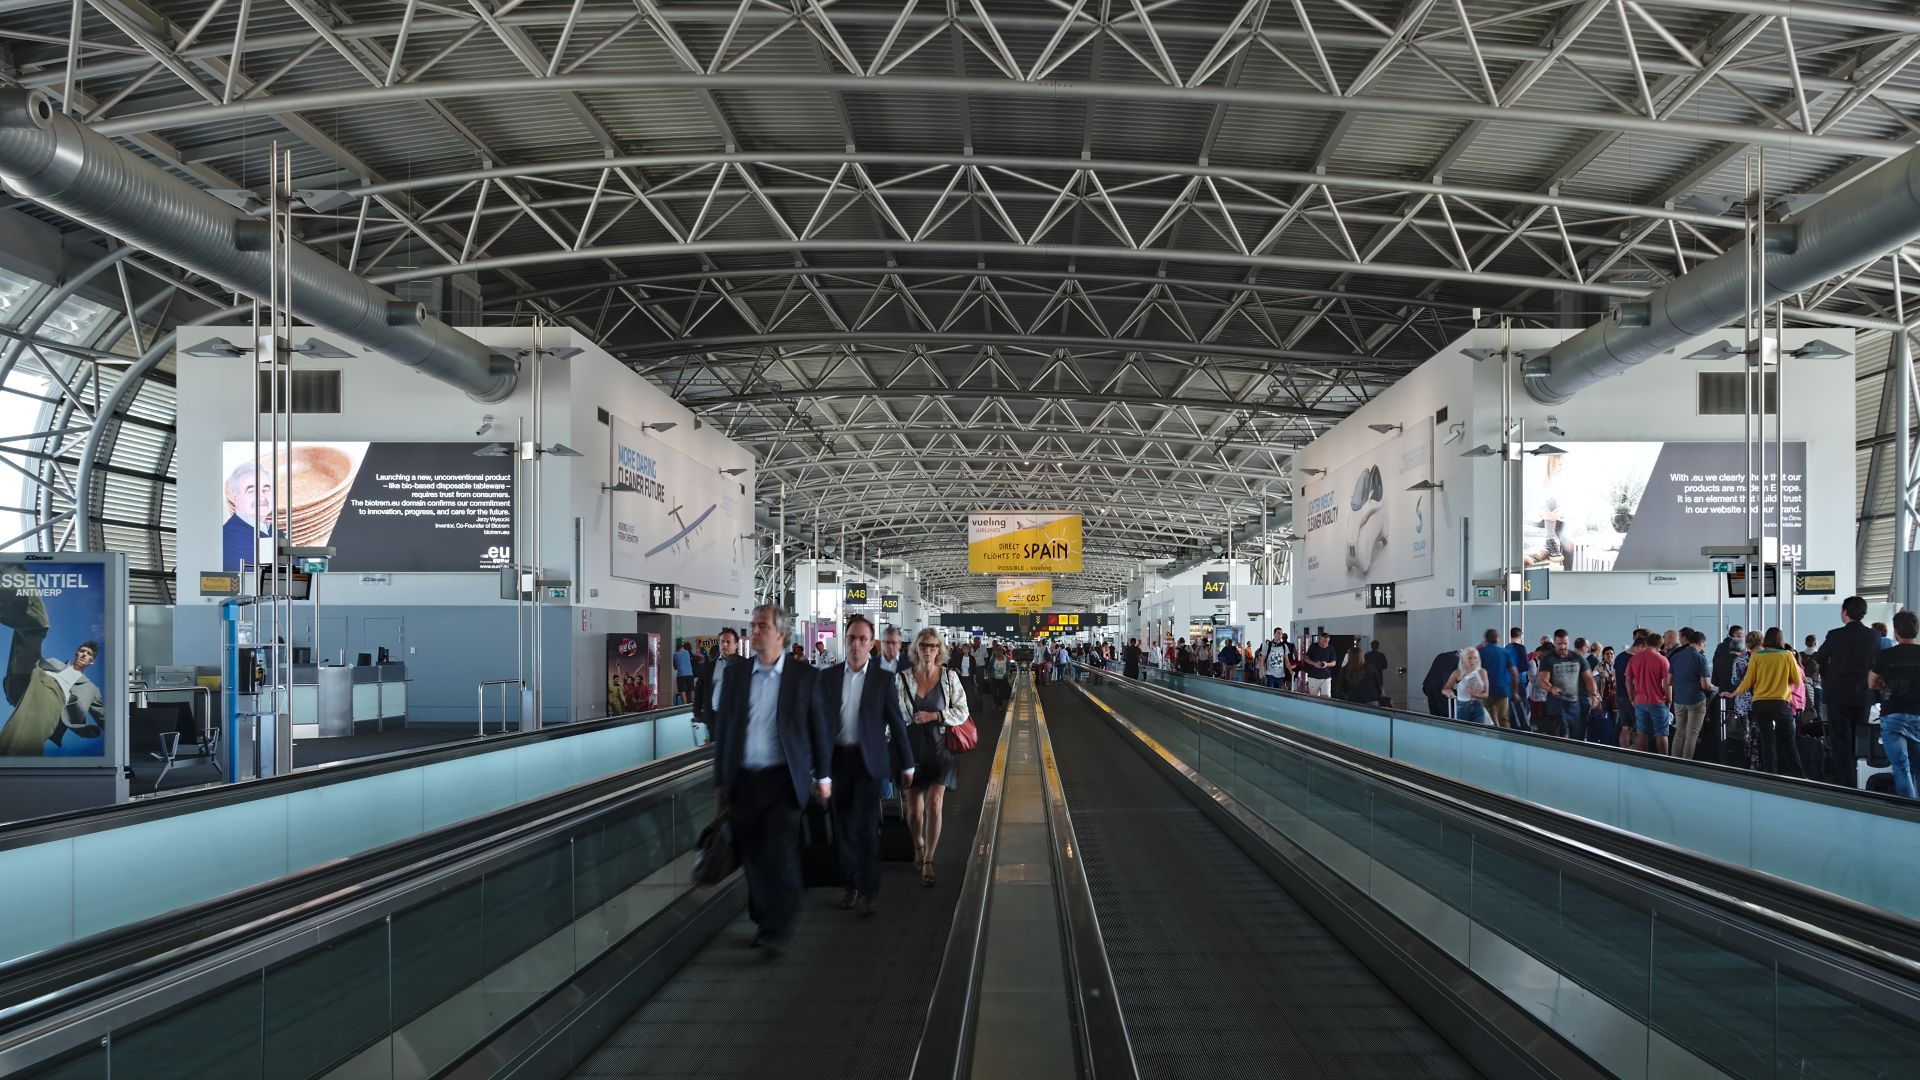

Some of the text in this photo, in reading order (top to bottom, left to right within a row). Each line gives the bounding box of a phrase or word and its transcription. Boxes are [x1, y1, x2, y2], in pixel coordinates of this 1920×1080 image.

[618, 443, 656, 479] MORE DARING
[376, 474, 410, 482] Launching
[1670, 473, 1689, 481] With
[1718, 473, 1745, 483] clearly
[1750, 473, 1768, 481] how
[1770, 473, 1786, 481] tht
[645, 478, 664, 503] FUTURE
[1684, 484, 1720, 493] products
[1771, 484, 1801, 493] Erope.
[1710, 506, 1741, 514] website
[1782, 505, 1801, 514] rand.
[972, 517, 1006, 528] vueling
[1782, 544, 1802, 556] eu
[0, 574, 88, 588] SSENTIEL
[1204, 582, 1225, 592] A47
[847, 589, 866, 599] A48
